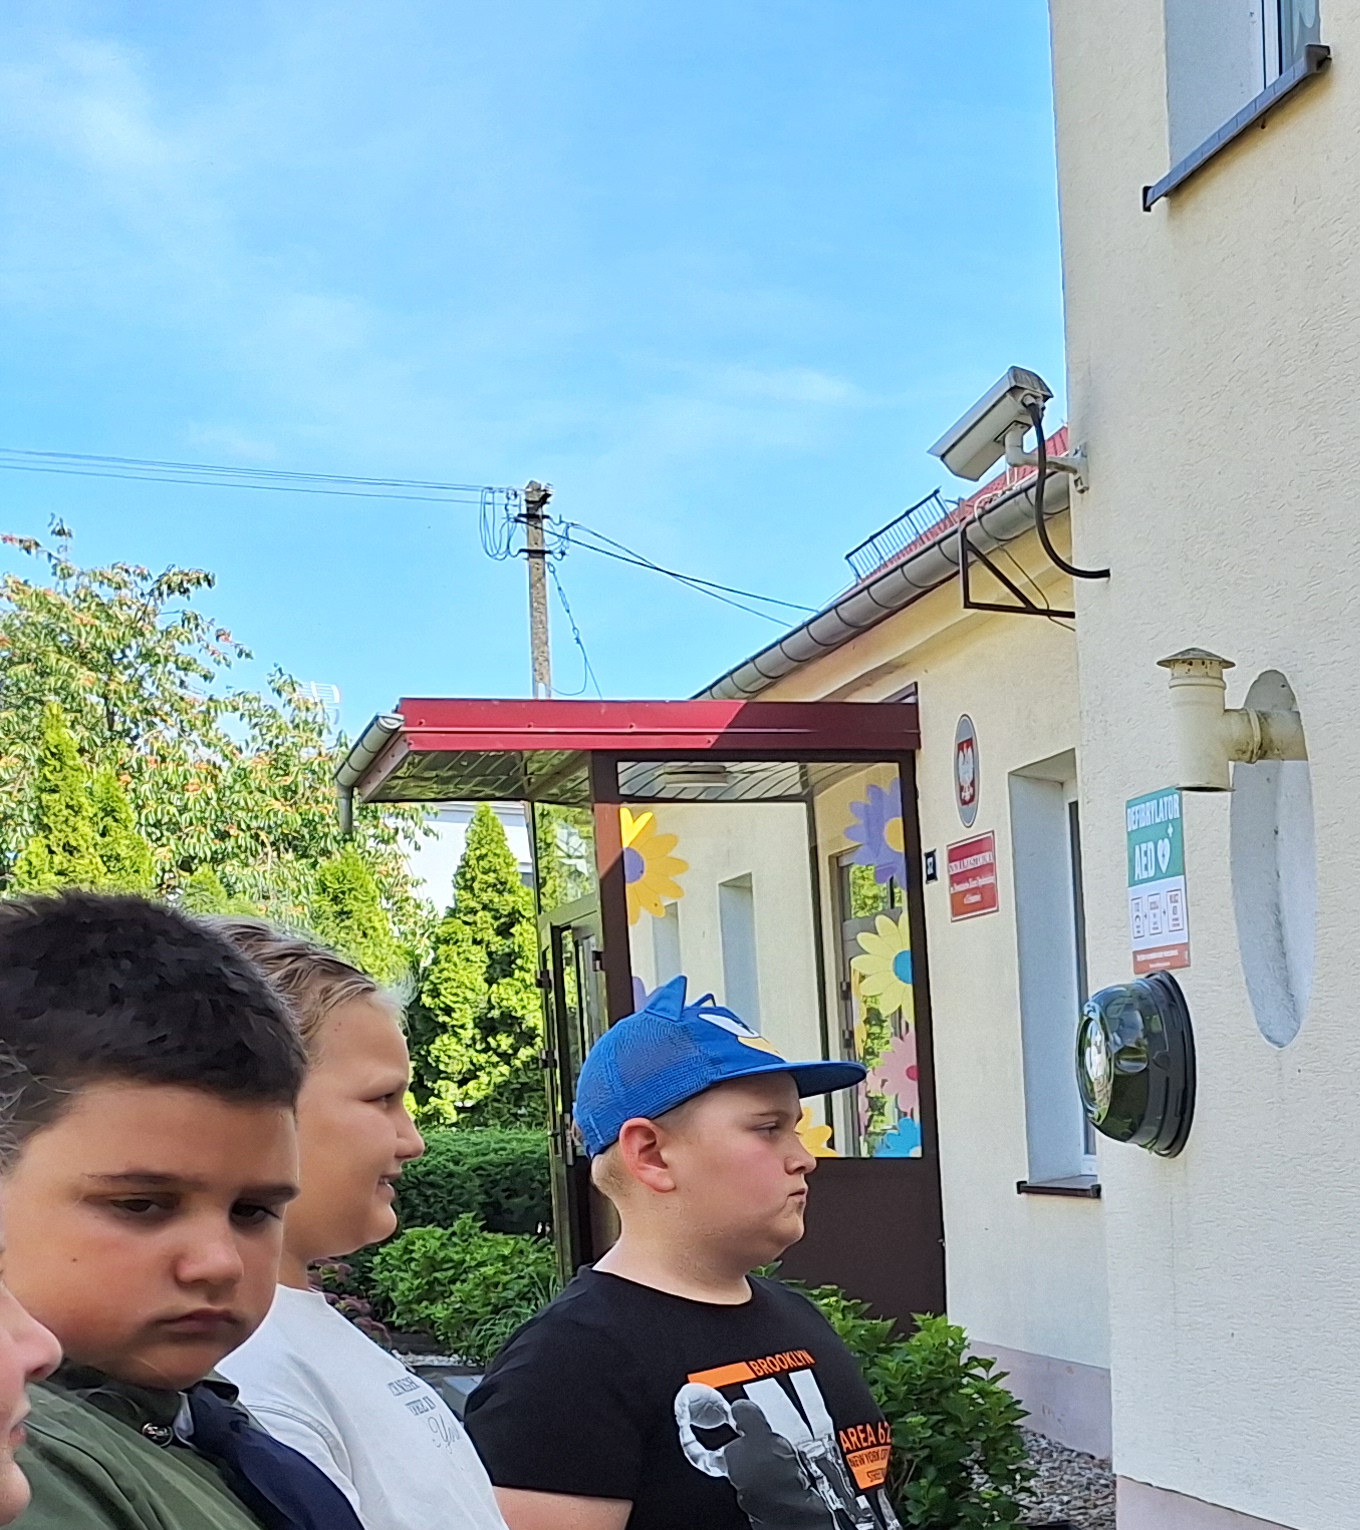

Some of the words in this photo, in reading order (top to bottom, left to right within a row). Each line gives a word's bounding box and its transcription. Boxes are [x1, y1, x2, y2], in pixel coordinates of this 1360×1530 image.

[1127, 793, 1180, 832] DEFIBRYLATOR
[1134, 840, 1155, 881] AED
[749, 1349, 815, 1377] BROOKLYN
[839, 1423, 877, 1452] AREA
